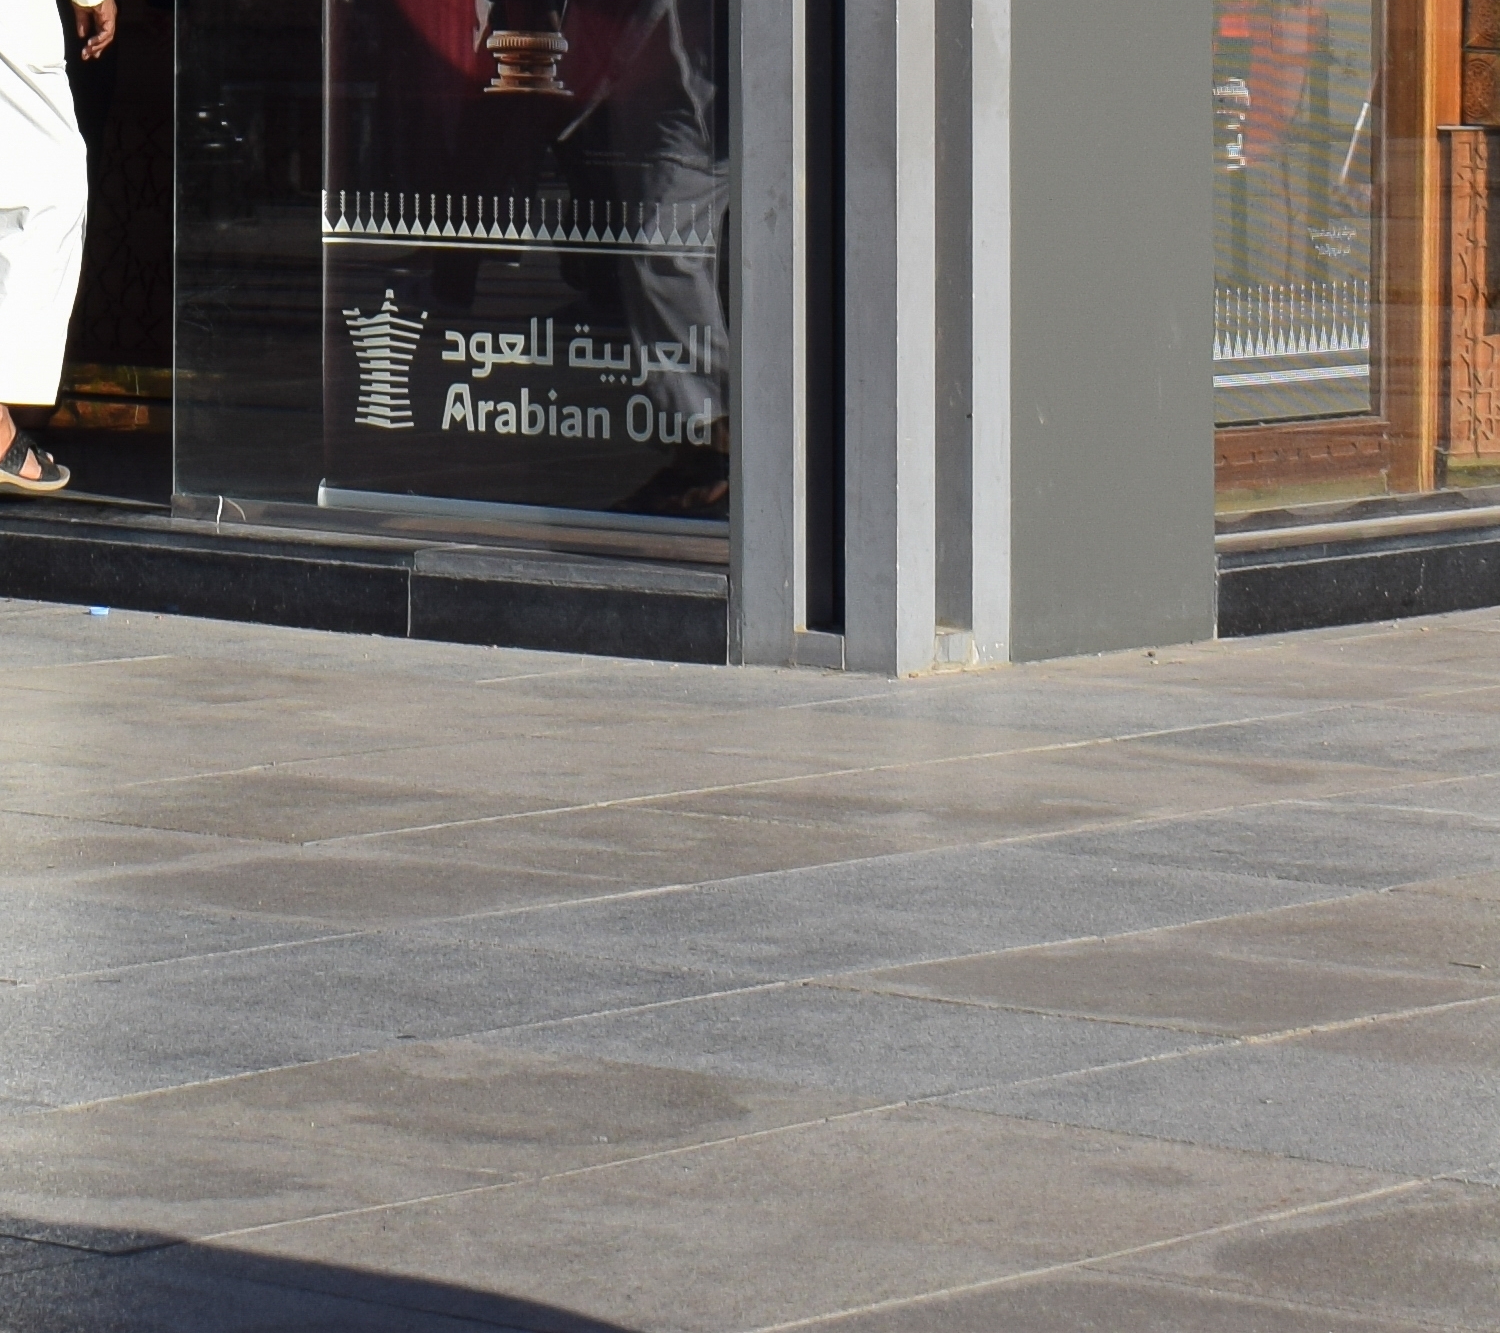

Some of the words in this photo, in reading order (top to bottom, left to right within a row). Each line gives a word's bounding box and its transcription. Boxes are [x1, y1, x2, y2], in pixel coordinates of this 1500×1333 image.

[441, 316, 554, 378] للعود
[568, 323, 712, 387] العربية
[441, 382, 611, 440] Arabian
[625, 393, 712, 446] Oud
